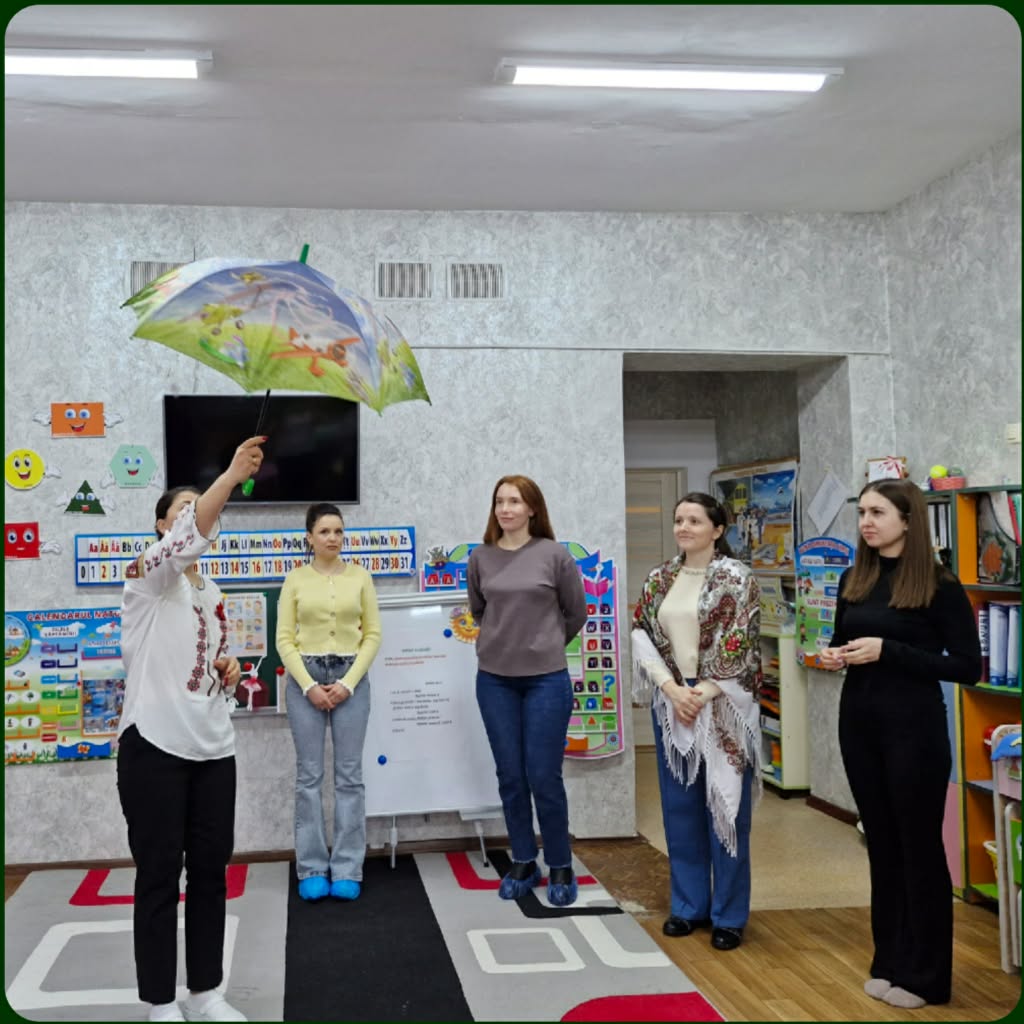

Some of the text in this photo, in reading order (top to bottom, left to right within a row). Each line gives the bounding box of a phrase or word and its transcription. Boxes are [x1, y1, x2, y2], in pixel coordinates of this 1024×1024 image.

[89, 543, 98, 553] Aa
[122, 541, 132, 553] Bb
[134, 541, 142, 553] Cc
[221, 539, 227, 553] Jj
[230, 539, 239, 550] Kk
[250, 539, 262, 550] Mm
[263, 539, 272, 549] Nn
[273, 538, 282, 548] Oo
[283, 537, 292, 551] Pp
[293, 537, 302, 551] Qq
[351, 536, 360, 546] Uu
[361, 535, 369, 546] Vv
[370, 535, 379, 546] Ww
[380, 535, 388, 545] Xx
[390, 534, 398, 547] Yy
[400, 534, 407, 545] Zz
[81, 565, 86, 579] 0
[91, 565, 95, 578] 1
[101, 565, 106, 579] 2
[113, 565, 117, 578] 3
[201, 562, 209, 576] 11
[211, 561, 219, 576] 12
[221, 561, 229, 576] 13
[231, 561, 239, 575] 14
[241, 561, 248, 575] 15
[252, 560, 261, 574] 16
[264, 560, 272, 573] 17
[274, 559, 283, 573] 18
[284, 559, 292, 573] 19
[371, 557, 380, 571] 28
[381, 556, 389, 571] 29
[391, 556, 399, 570] 30
[400, 556, 408, 570] 31
[27, 611, 92, 622] CALENDARUL
